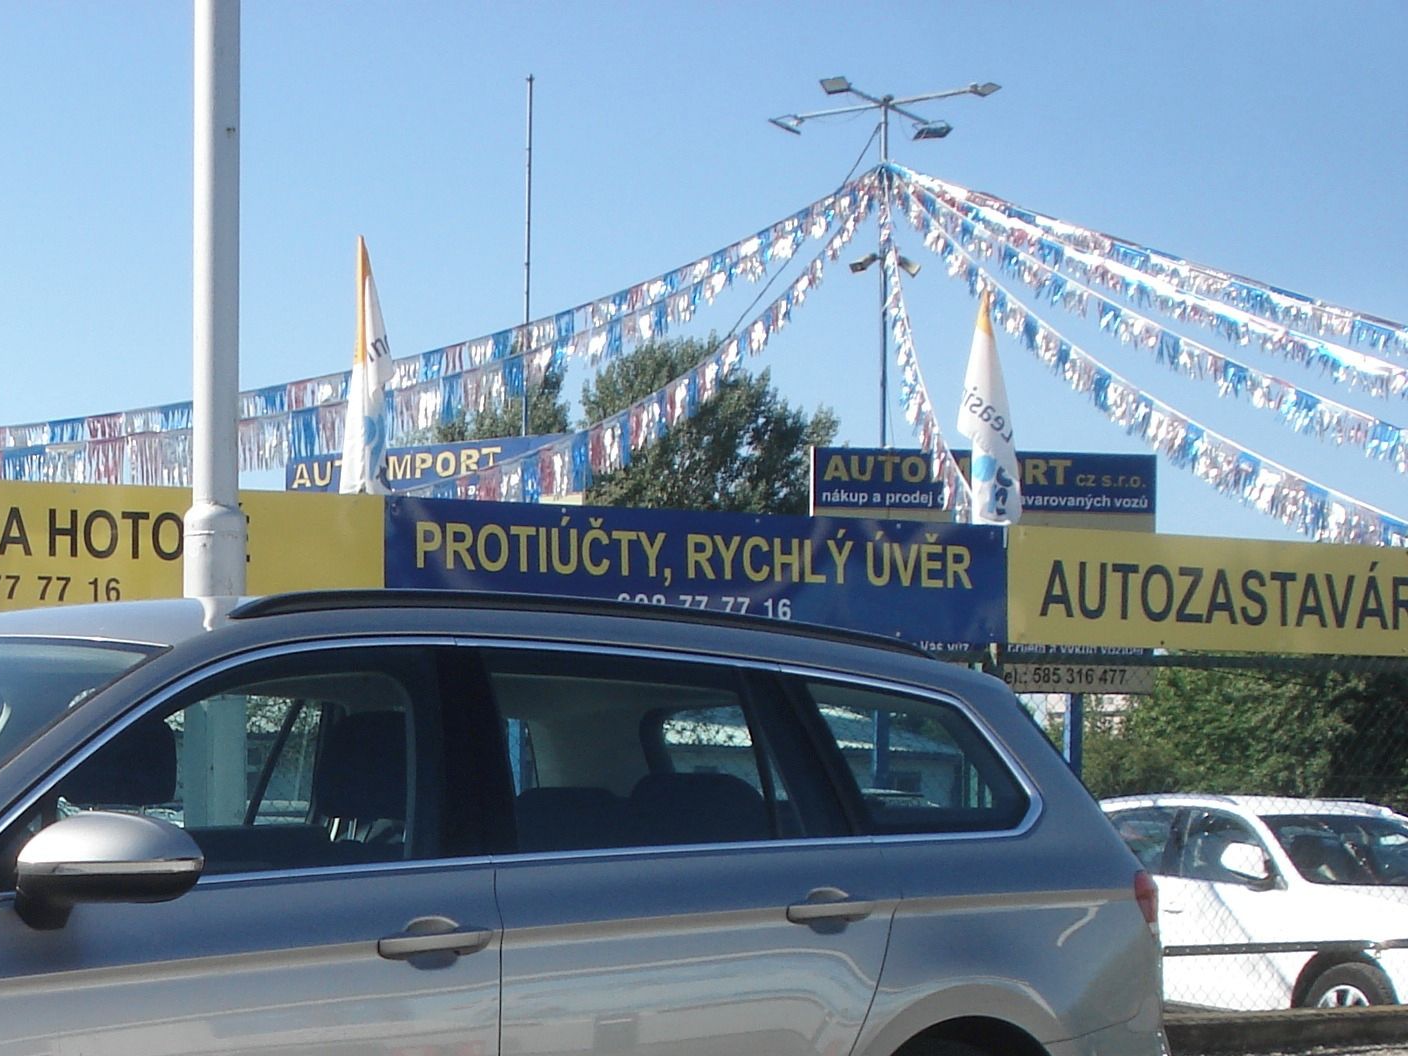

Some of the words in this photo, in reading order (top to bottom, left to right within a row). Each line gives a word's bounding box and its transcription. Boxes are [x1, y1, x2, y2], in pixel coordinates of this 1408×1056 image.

[291, 446, 502, 489] AUMPORT
[823, 454, 1073, 486] AUTORT
[1076, 473, 1096, 487] cz
[1101, 474, 1147, 489] s.r.o.
[821, 489, 868, 505] nákup
[872, 492, 882, 504] a
[886, 490, 933, 507] prodej
[415, 516, 672, 587] PROTIÚČTY,
[687, 529, 854, 585] RYCHLÝ
[866, 530, 972, 590] ÚVĚR
[37, 575, 72, 602] 77
[88, 577, 122, 603] 16
[763, 598, 792, 620] 16
[1032, 667, 1062, 685] 585
[1066, 668, 1095, 685] 316
[1099, 669, 1128, 686] 477
